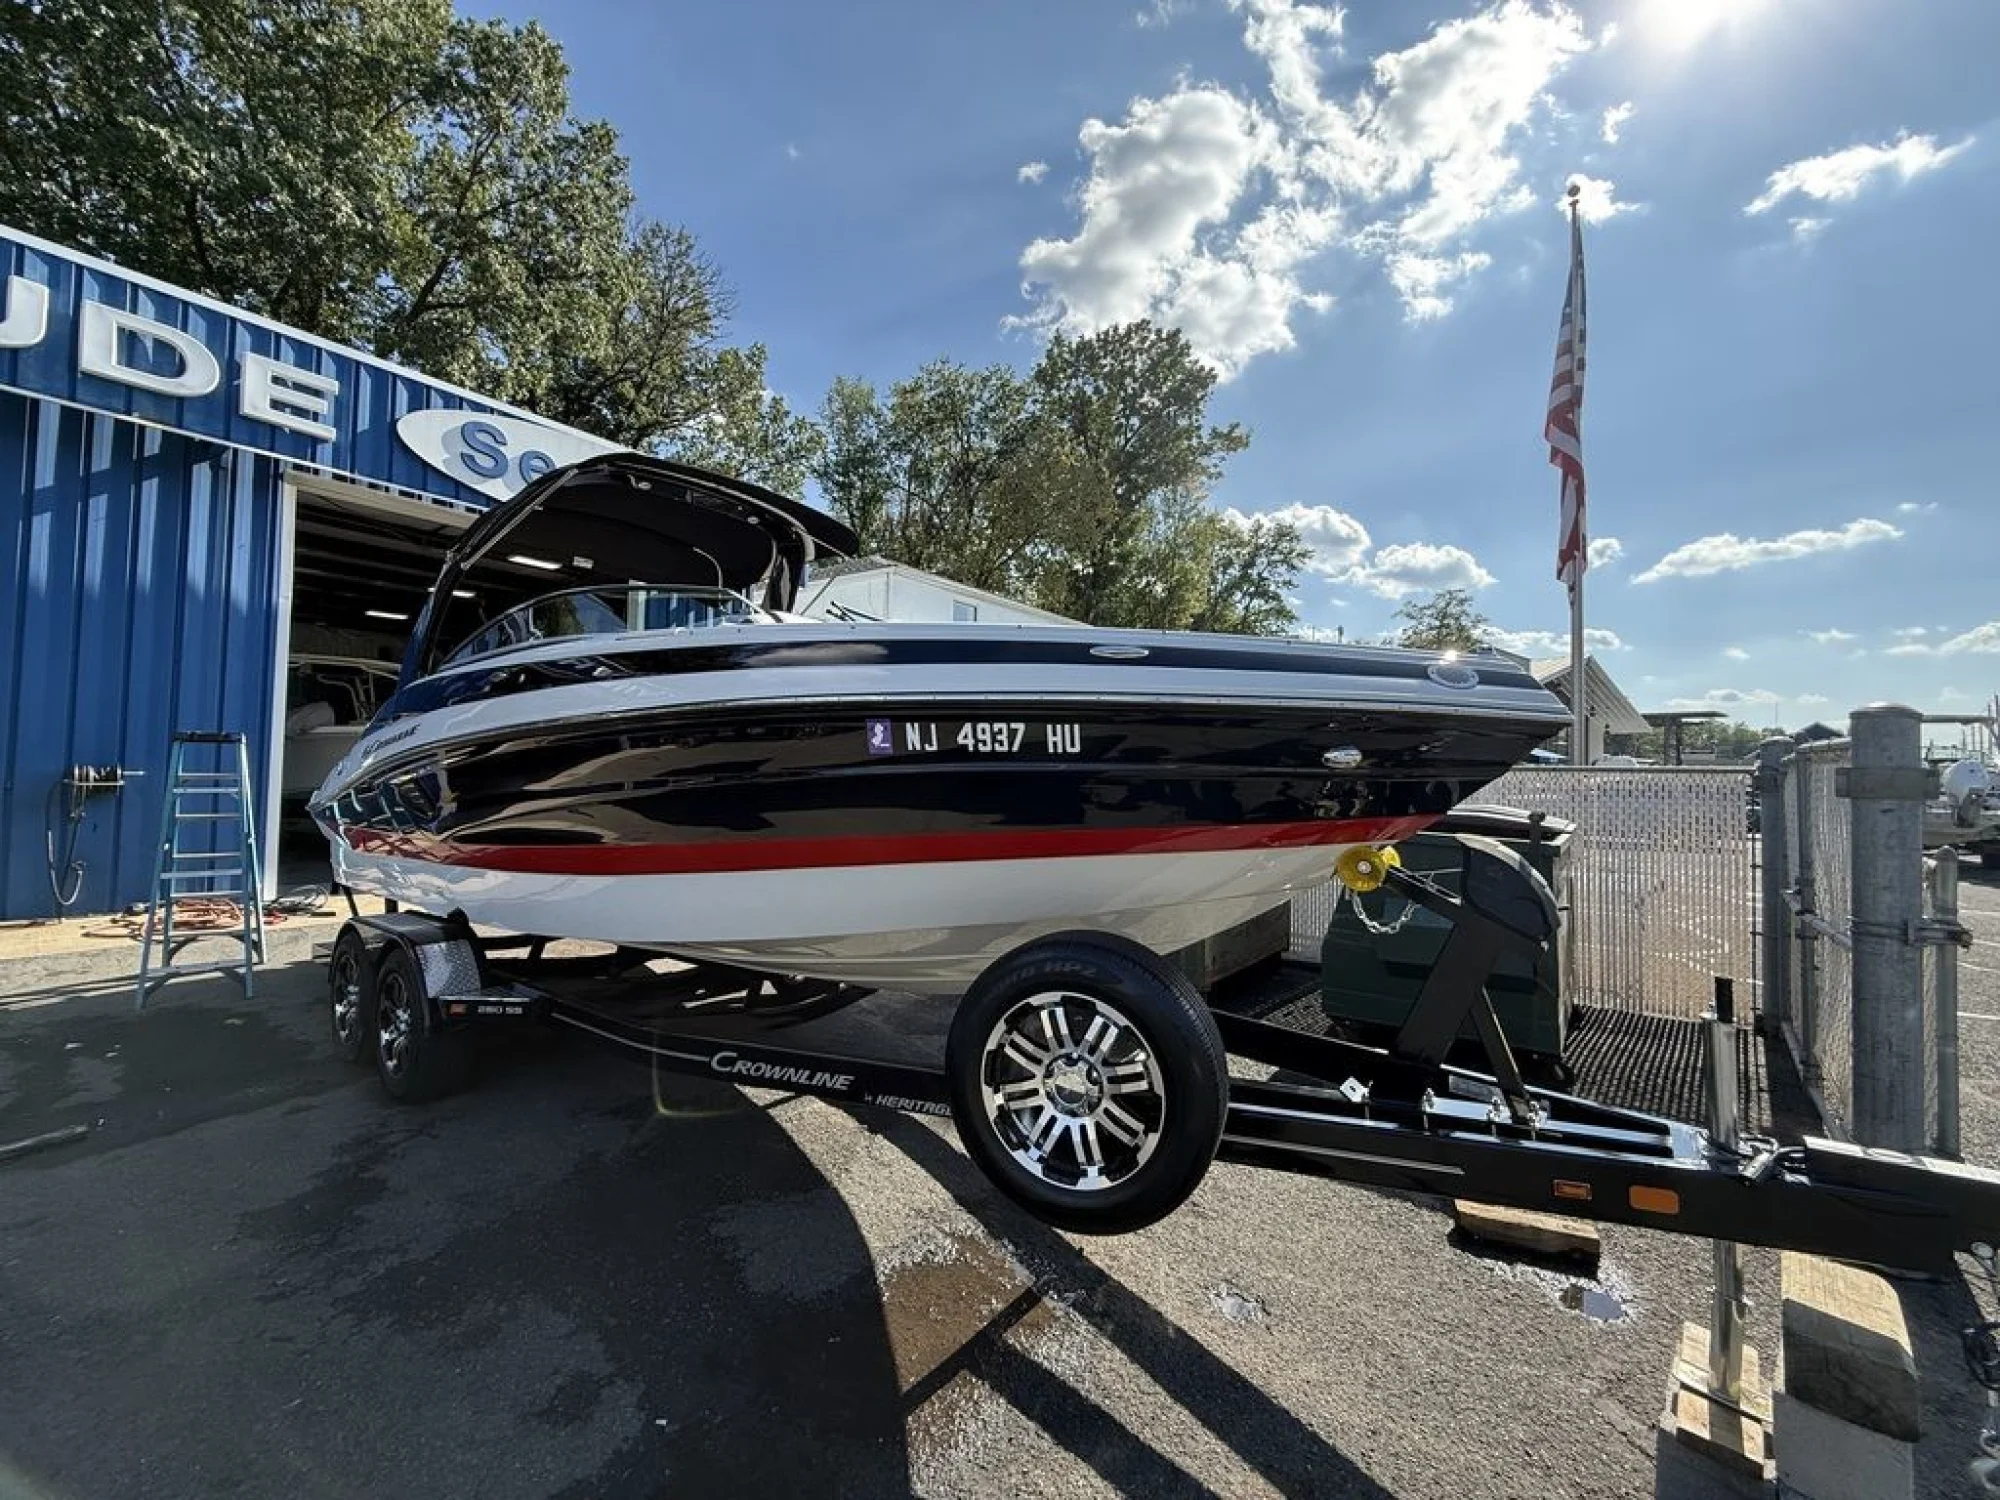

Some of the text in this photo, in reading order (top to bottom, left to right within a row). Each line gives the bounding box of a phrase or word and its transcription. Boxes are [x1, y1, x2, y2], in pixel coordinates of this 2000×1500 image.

[905, 722, 1081, 753] NJ 4937 HU
